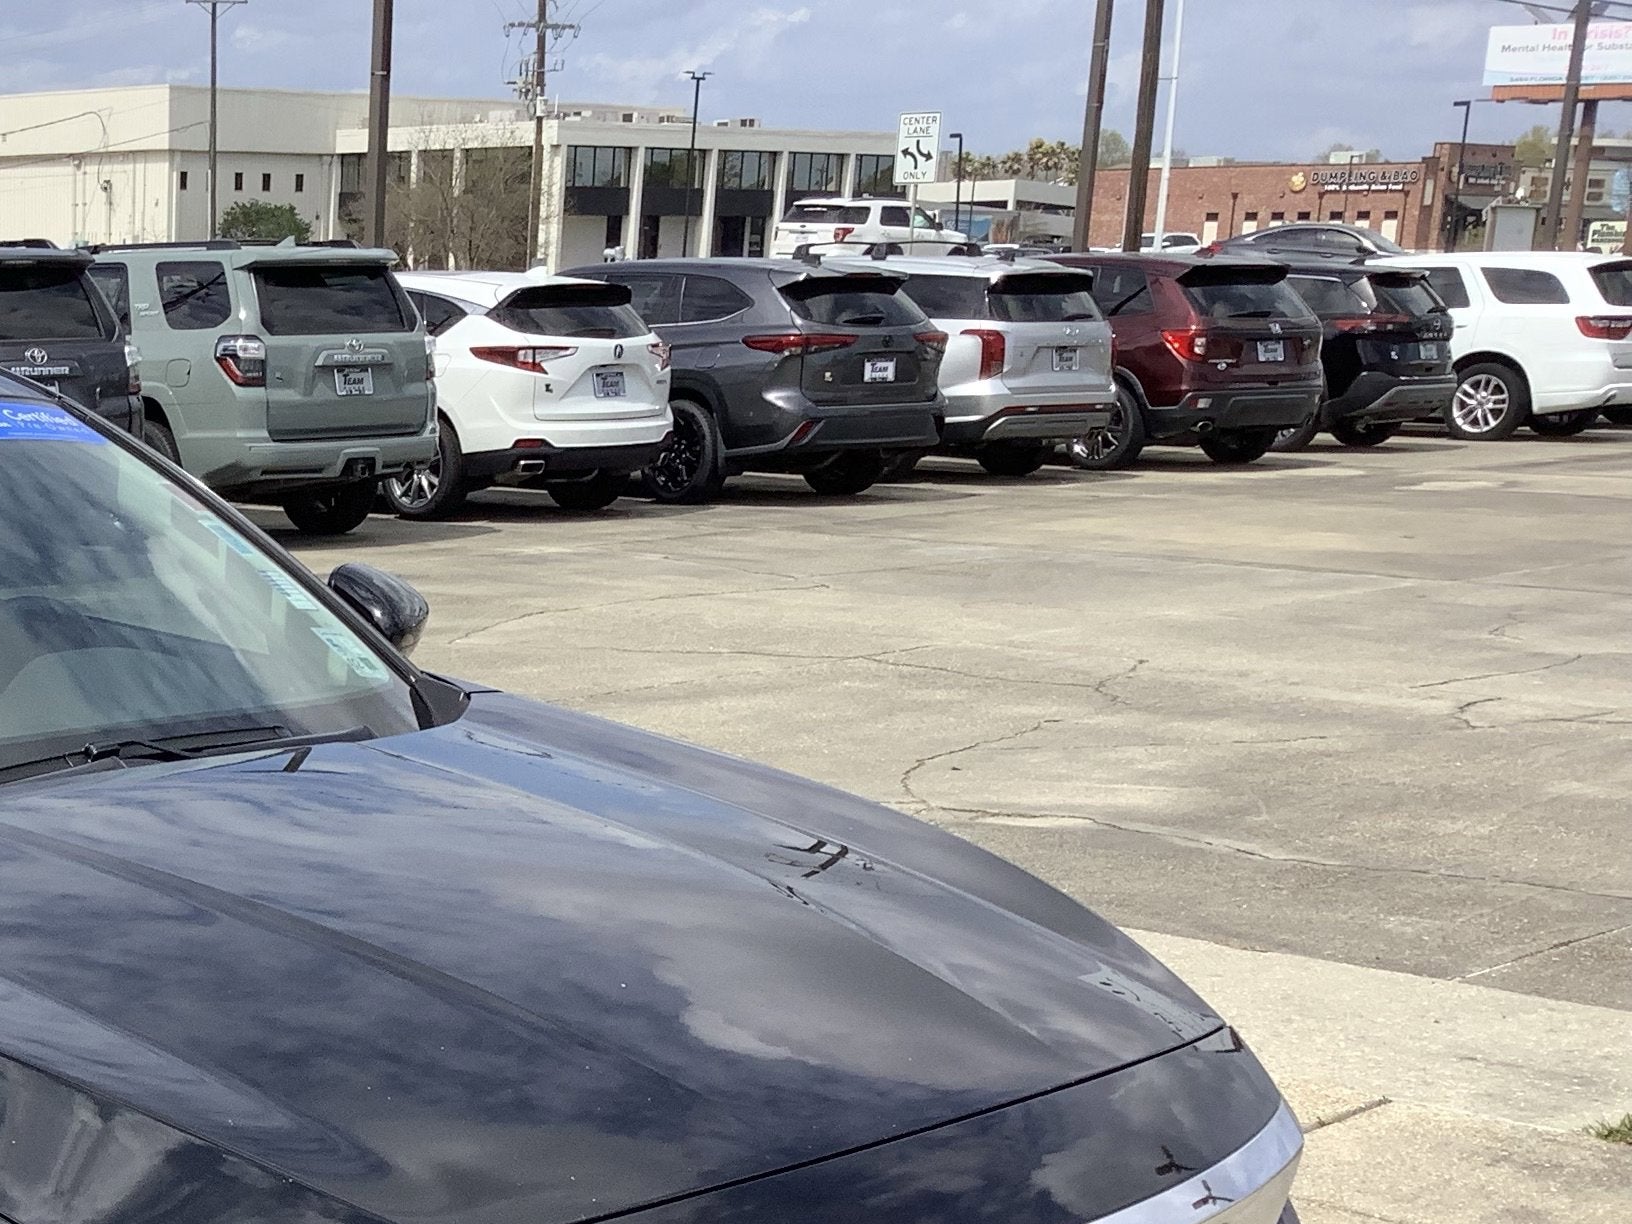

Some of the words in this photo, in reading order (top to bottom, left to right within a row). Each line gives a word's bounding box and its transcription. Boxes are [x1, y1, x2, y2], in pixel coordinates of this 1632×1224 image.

[1552, 27, 1569, 40] In
[1585, 25, 1632, 39] risis?
[1501, 44, 1539, 53] Mental
[1542, 43, 1574, 52] Healt
[903, 116, 937, 126] CENTER
[907, 126, 931, 135] LANE
[903, 171, 927, 180] ONLY
[1393, 170, 1419, 182] BAO
